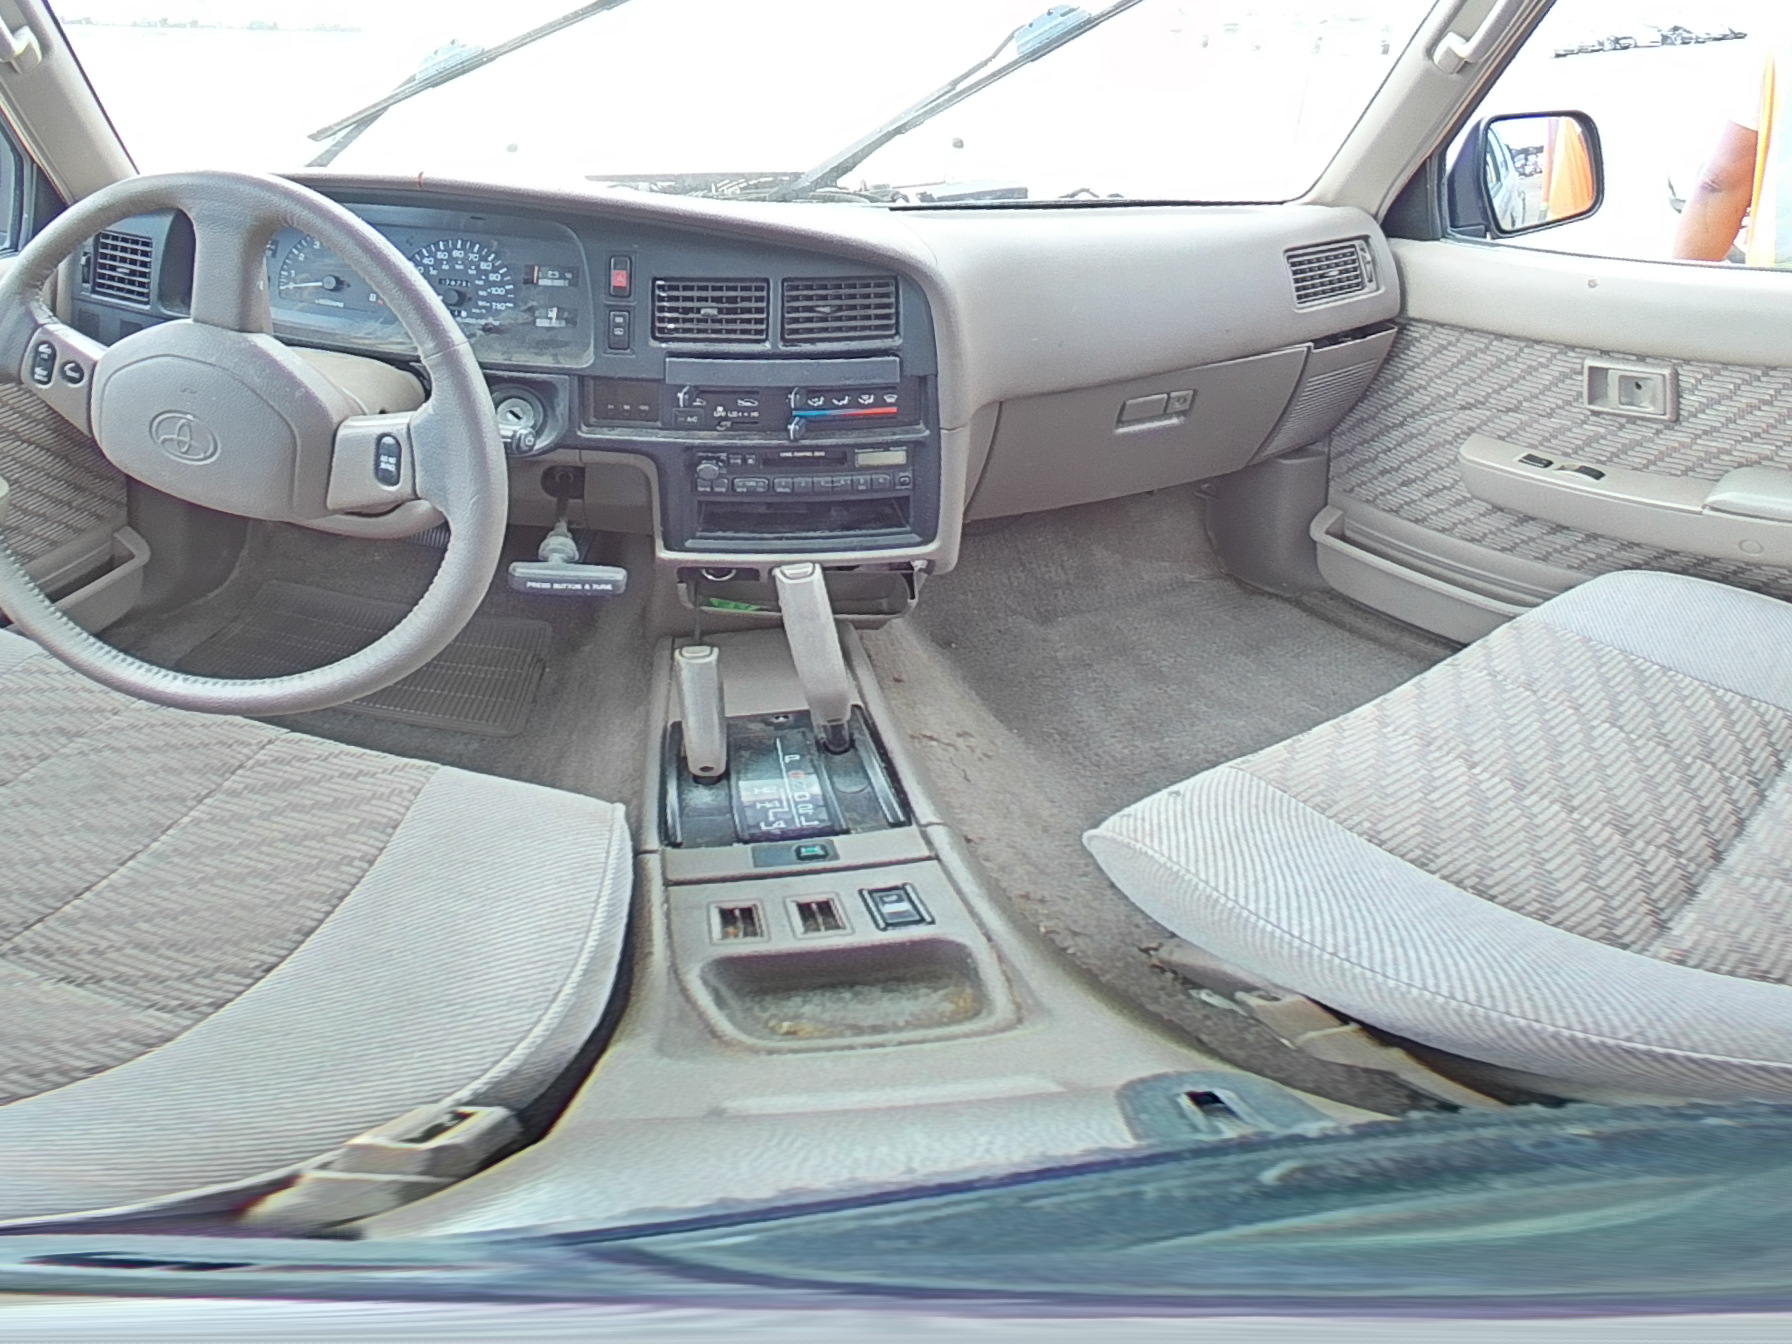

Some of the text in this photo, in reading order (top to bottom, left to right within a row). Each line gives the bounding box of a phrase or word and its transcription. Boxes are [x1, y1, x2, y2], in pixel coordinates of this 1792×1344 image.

[490, 286, 506, 296] 100
[784, 754, 801, 764] P
[794, 791, 811, 802] D
[800, 815, 821, 826] L
